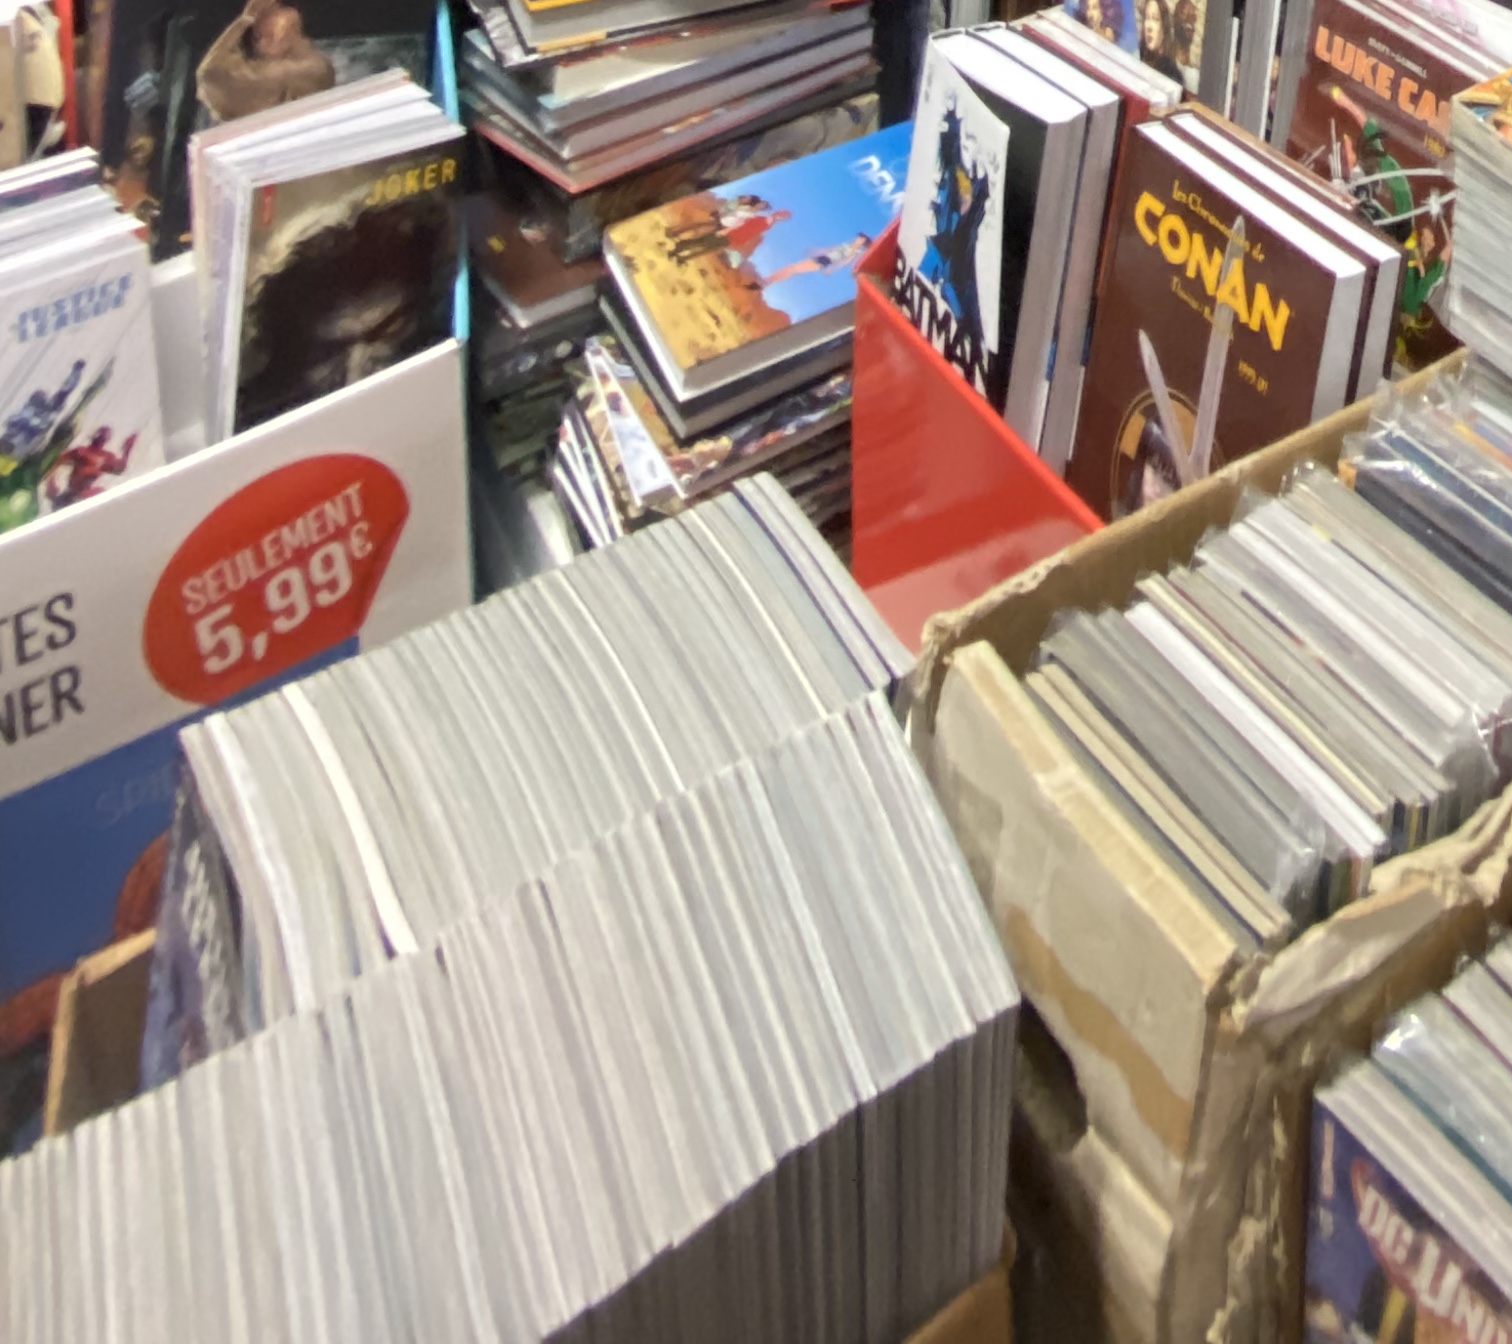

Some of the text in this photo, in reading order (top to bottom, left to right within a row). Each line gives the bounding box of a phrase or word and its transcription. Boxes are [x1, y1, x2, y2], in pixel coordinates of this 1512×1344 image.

[1315, 24, 1396, 102] LUKE
[365, 157, 457, 206] JOKER
[17, 273, 134, 327] JUSTICE
[1135, 190, 1291, 351] CONAN
[181, 480, 366, 616] SEULEMENT
[193, 522, 376, 677] 5,99€
